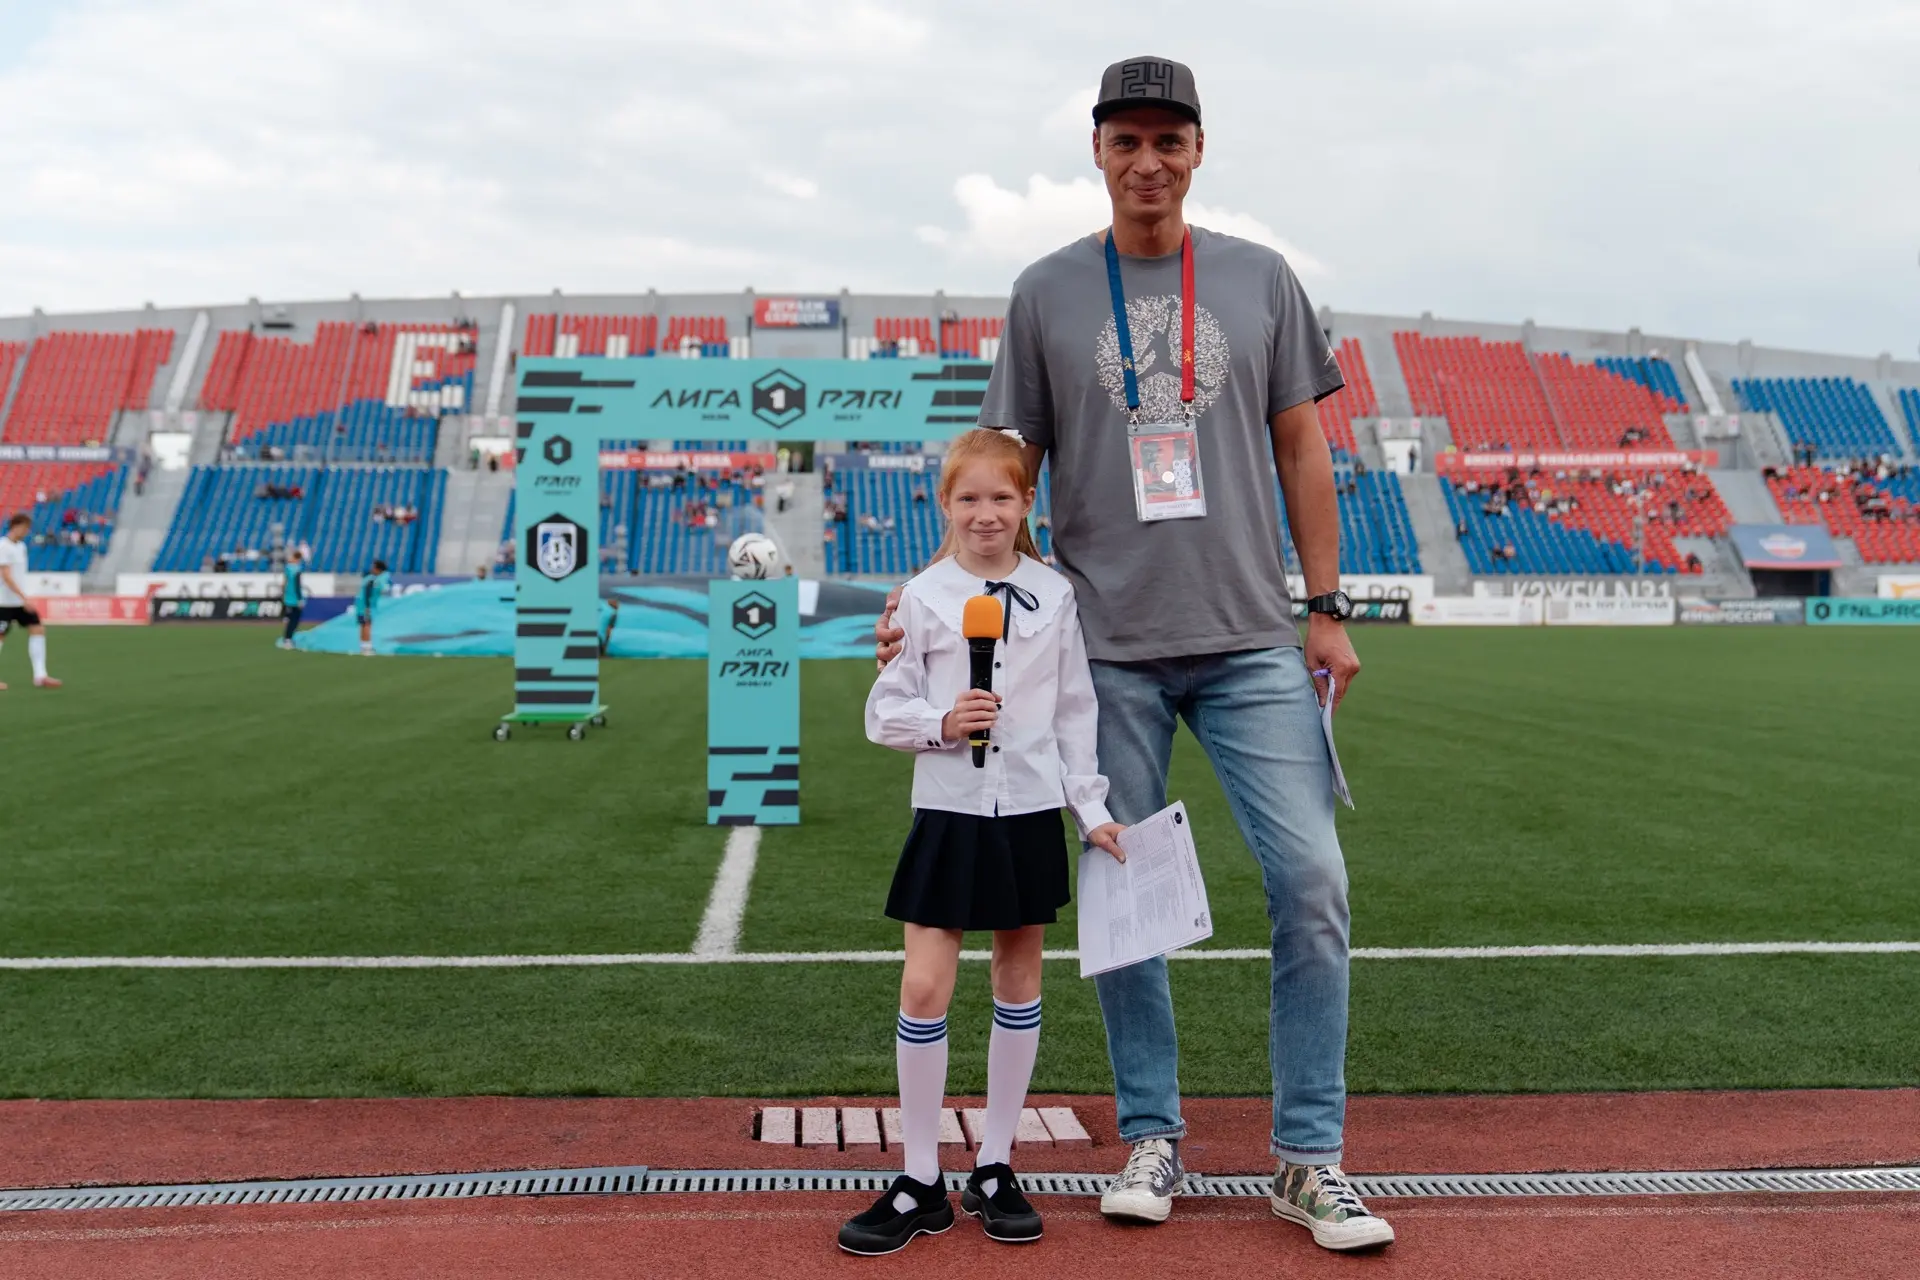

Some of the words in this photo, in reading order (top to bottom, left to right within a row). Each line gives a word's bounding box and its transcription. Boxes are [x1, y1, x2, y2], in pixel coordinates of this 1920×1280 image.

[1121, 61, 1173, 98] 24
[650, 389, 742, 408] ЛИГА
[769, 388, 786, 409] 1
[816, 389, 903, 409] PARI
[158, 601, 215, 618] PARI
[227, 601, 283, 618] PARI
[746, 607, 760, 624] 1
[1350, 602, 1403, 619] PARI
[736, 648, 774, 658] ЛИГА
[718, 661, 790, 678] PARI
